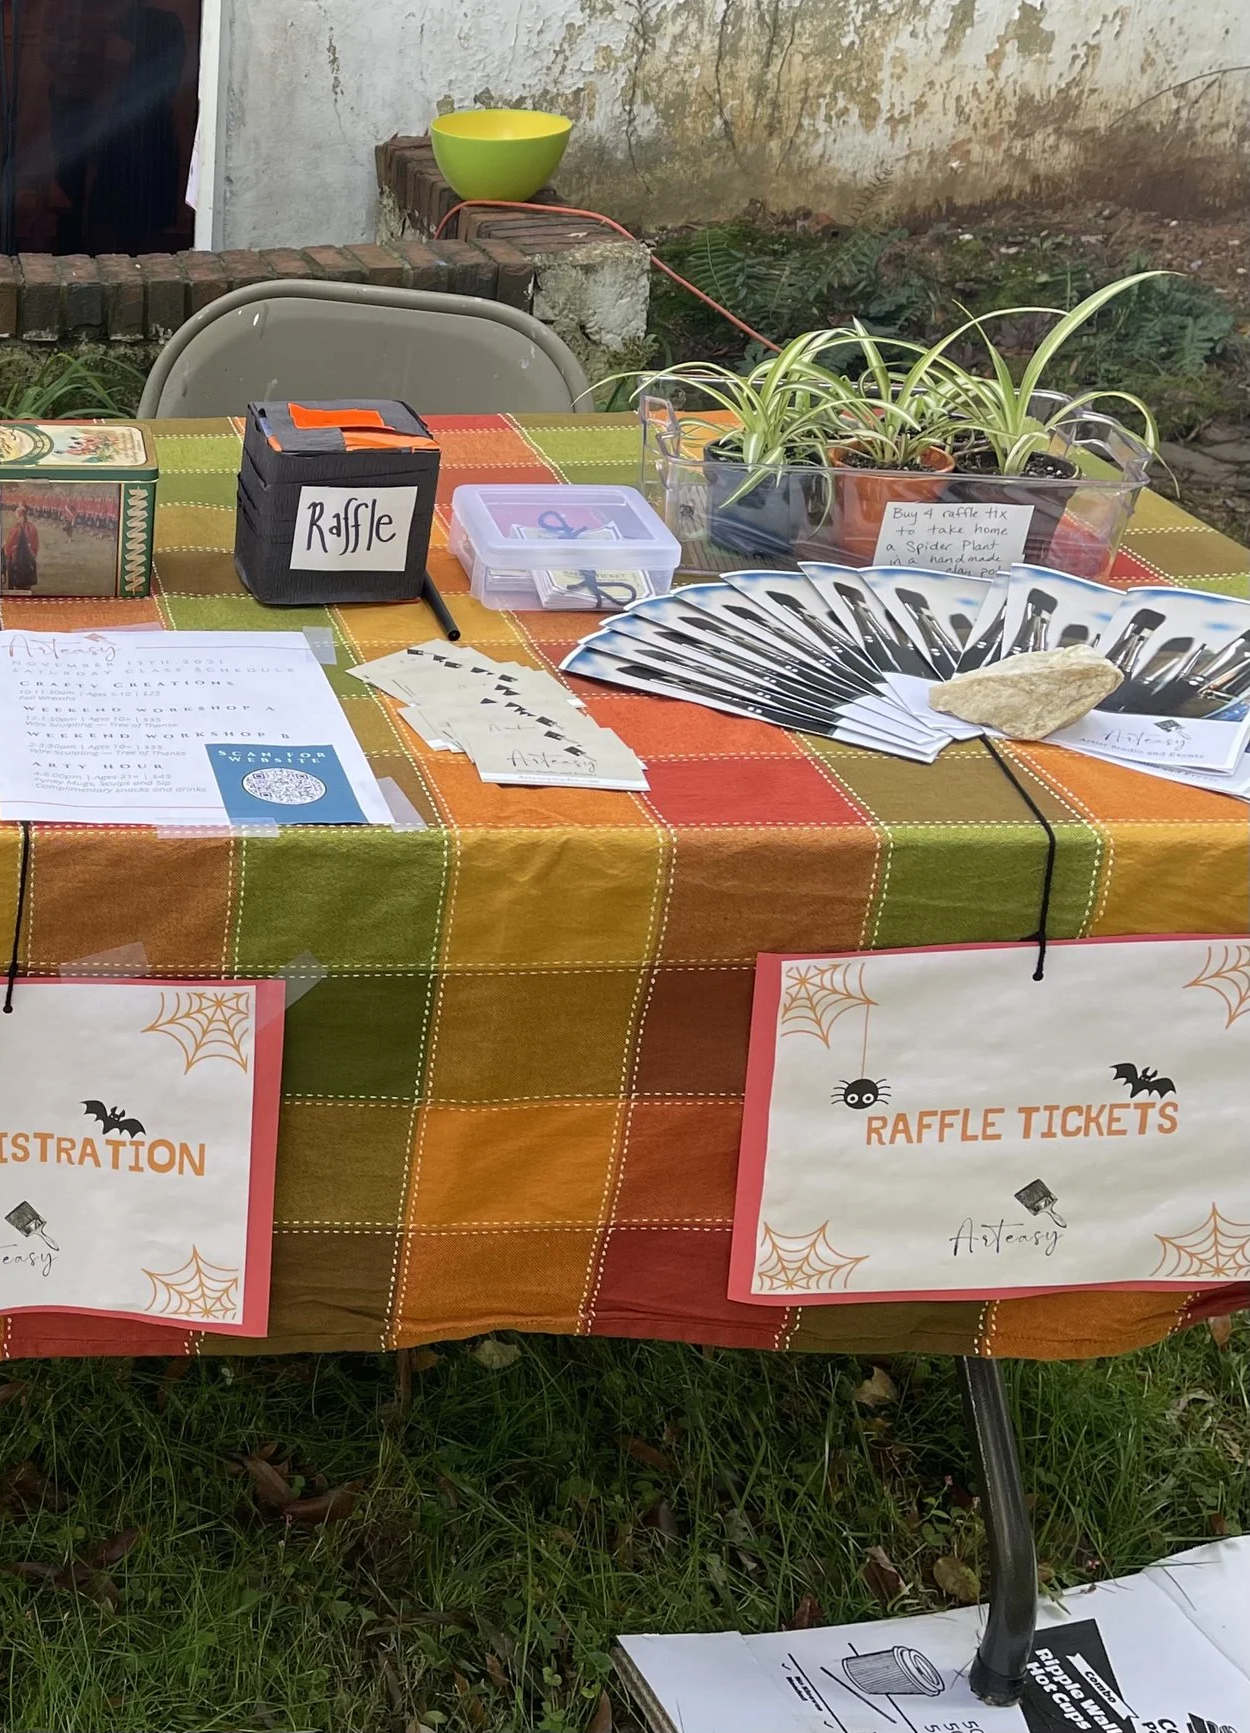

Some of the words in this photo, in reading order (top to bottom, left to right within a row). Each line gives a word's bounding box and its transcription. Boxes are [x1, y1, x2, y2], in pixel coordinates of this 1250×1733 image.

[893, 507, 918, 526] Buy
[923, 507, 933, 519] 4
[942, 505, 978, 519] raffle
[985, 506, 1007, 520] tix
[306, 497, 397, 556] Raffle
[896, 525, 915, 536] to
[927, 524, 964, 535] take
[974, 523, 1008, 536] home
[886, 543, 896, 551] a
[906, 541, 953, 554] Spider
[962, 540, 999, 551] Plant
[19, 681, 99, 689] CRAFTY
[113, 679, 234, 688] CREATIONS
[22, 705, 121, 713] WEEKEND
[136, 705, 250, 714] WORKSHOP
[27, 730, 130, 739] WEEKEND
[146, 730, 265, 740] WORKSHOP
[218, 749, 272, 758] SCAN
[228, 755, 321, 764] WEBSITE
[32, 761, 87, 769] ARTY
[866, 1107, 1004, 1146] RAFFLE
[1016, 1101, 1180, 1140] TICKETS
[1034, 1647, 1086, 1700] Ripple
[1084, 1670, 1117, 1704] Combo
[1025, 1661, 1058, 1693] Hot
[1051, 1692, 1093, 1731] Cups
